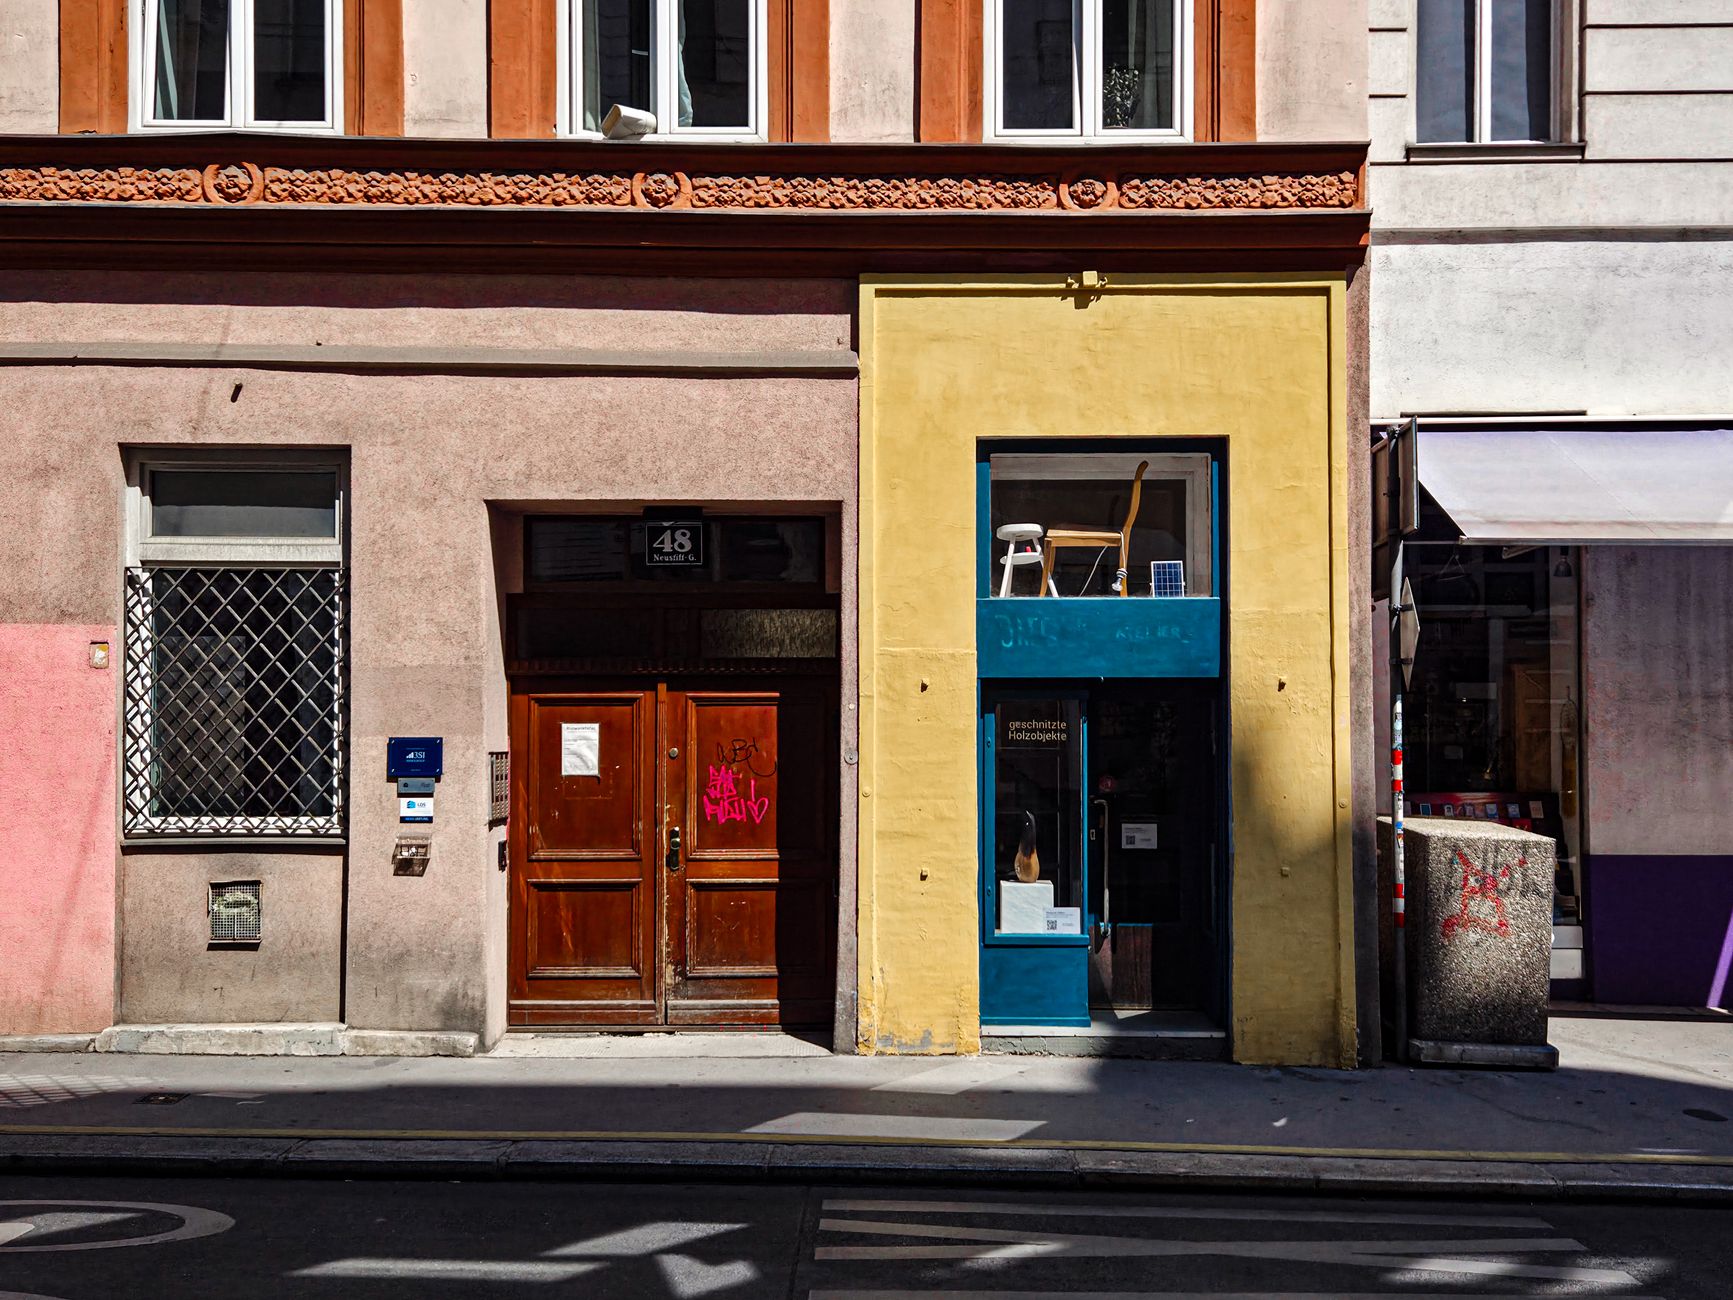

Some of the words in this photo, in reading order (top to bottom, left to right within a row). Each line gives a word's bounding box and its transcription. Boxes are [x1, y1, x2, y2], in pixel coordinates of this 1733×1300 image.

[653, 529, 692, 552] 48
[1009, 720, 1067, 731] geschnitzte
[1008, 731, 1067, 742] Holzobjekte
